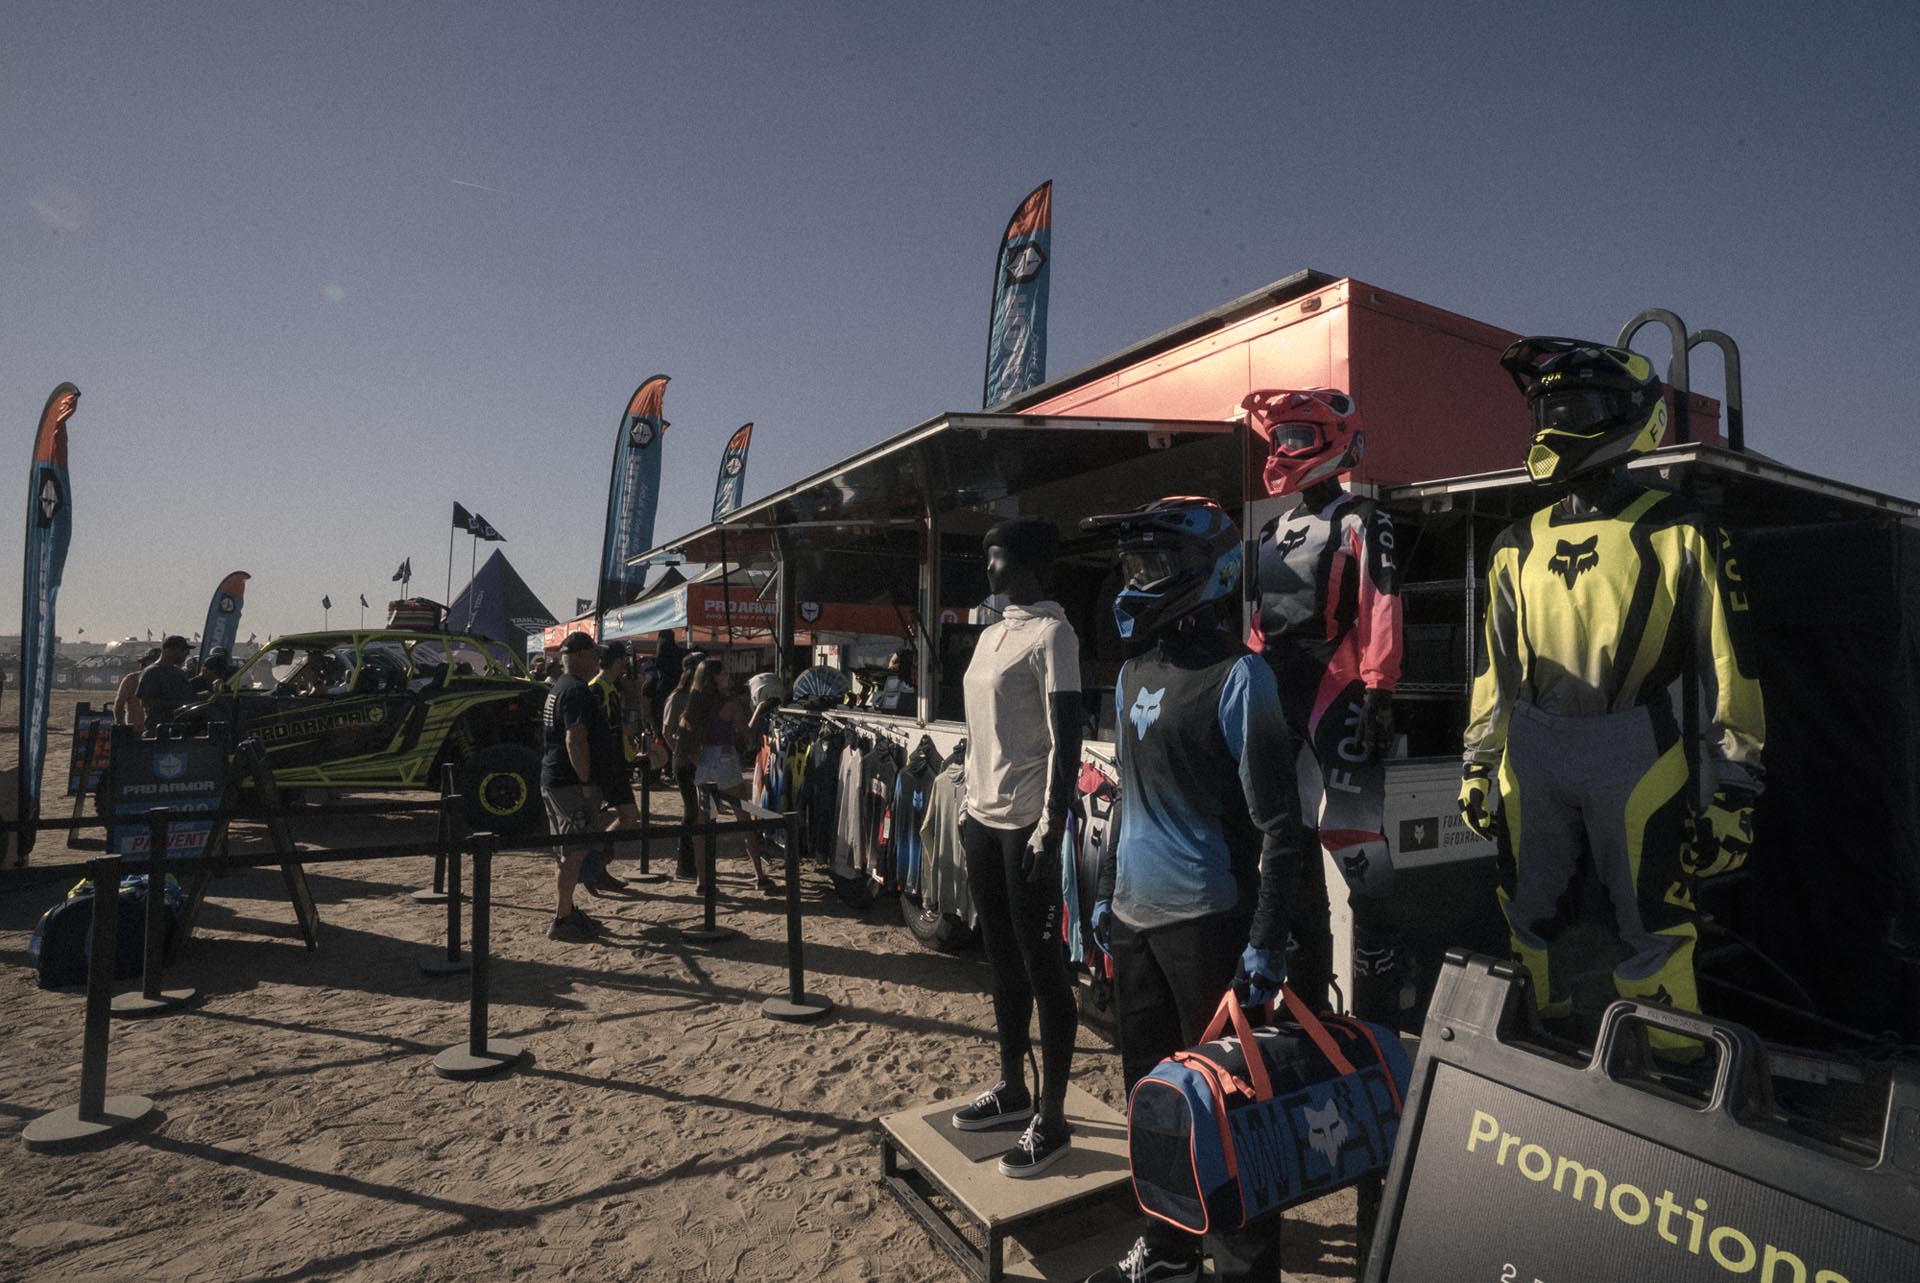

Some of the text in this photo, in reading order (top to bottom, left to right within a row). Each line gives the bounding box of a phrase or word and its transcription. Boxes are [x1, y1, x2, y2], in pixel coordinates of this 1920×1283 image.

[1541, 372, 1562, 384] FOX
[1375, 509, 1397, 570] FOX
[703, 600, 737, 612] PRO
[122, 780, 216, 796] PRO ARMOR
[1045, 904, 1057, 928] FOX
